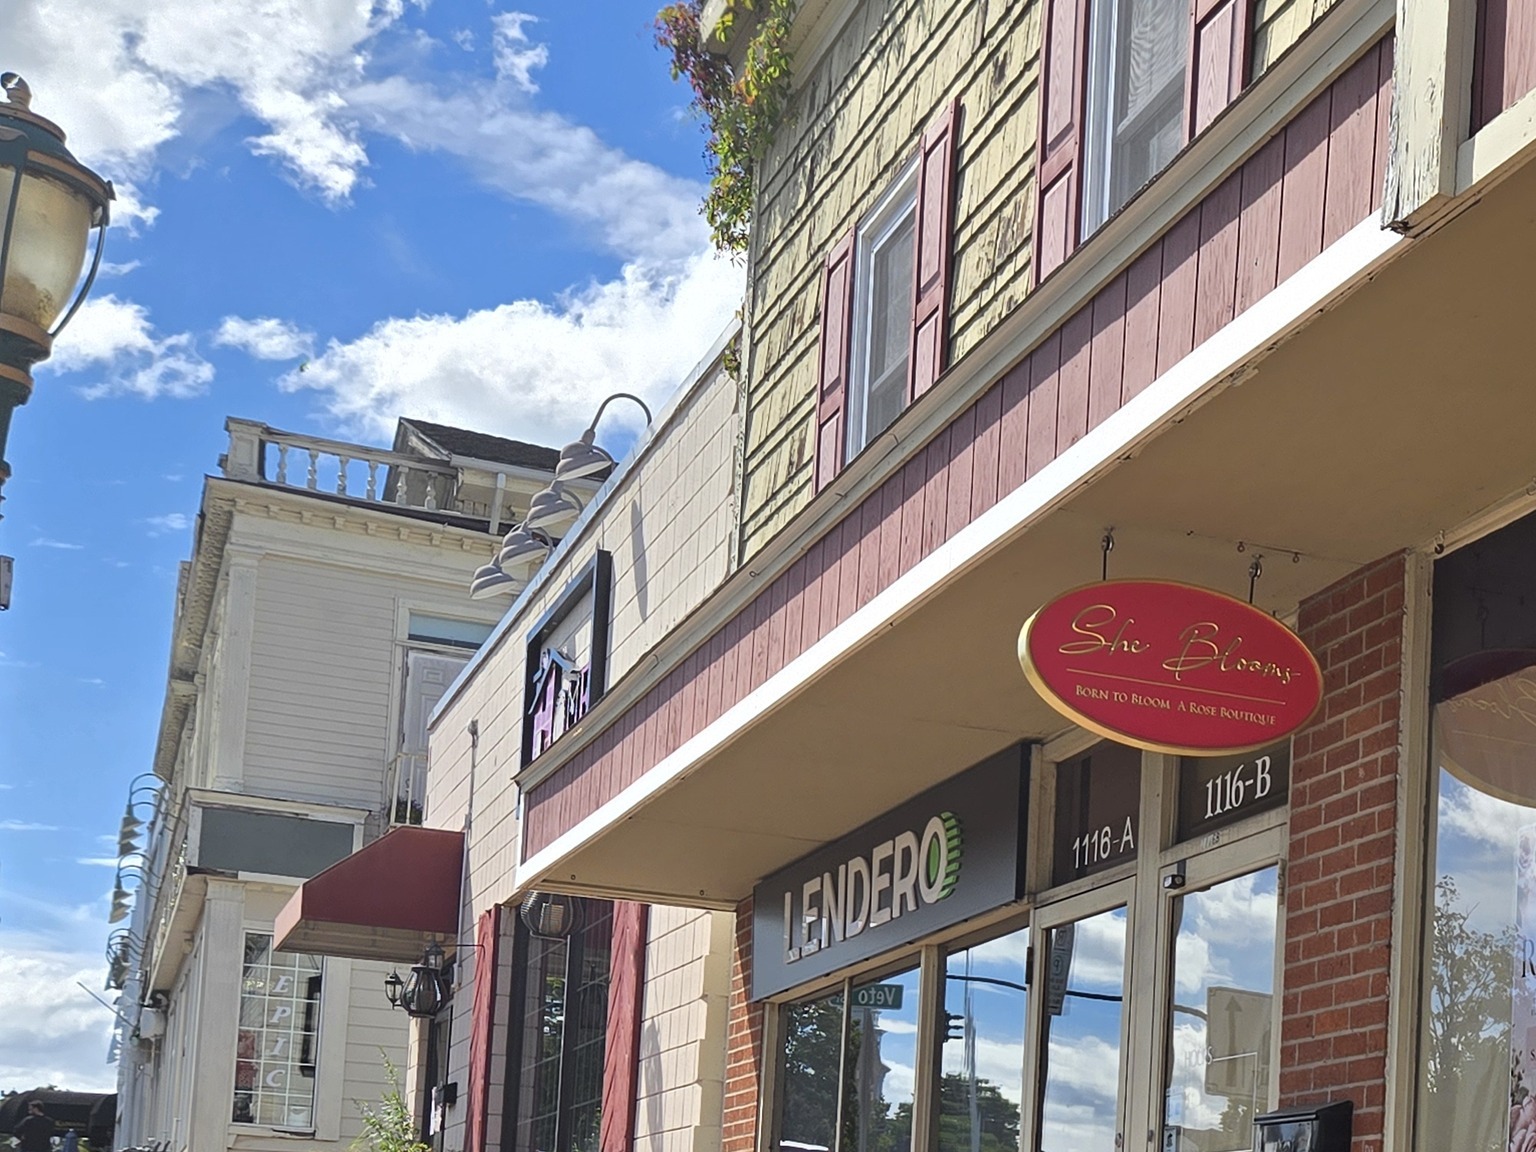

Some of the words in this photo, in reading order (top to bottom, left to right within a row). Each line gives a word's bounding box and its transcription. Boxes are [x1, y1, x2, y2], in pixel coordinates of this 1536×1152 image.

[1058, 604, 1150, 656] She
[1162, 622, 1301, 685] Blooms
[1075, 685, 1109, 701] BORN
[1112, 691, 1128, 702] TO
[1131, 692, 1171, 710] BLOOM
[1177, 700, 1187, 712] A
[1189, 701, 1217, 718] ROSE
[1220, 707, 1276, 726] BOUTIQUE
[1204, 755, 1271, 819] 1116-B
[1072, 815, 1134, 869] 1116-A
[783, 815, 955, 965] LENDERO
[265, 975, 294, 1088] EPIC
